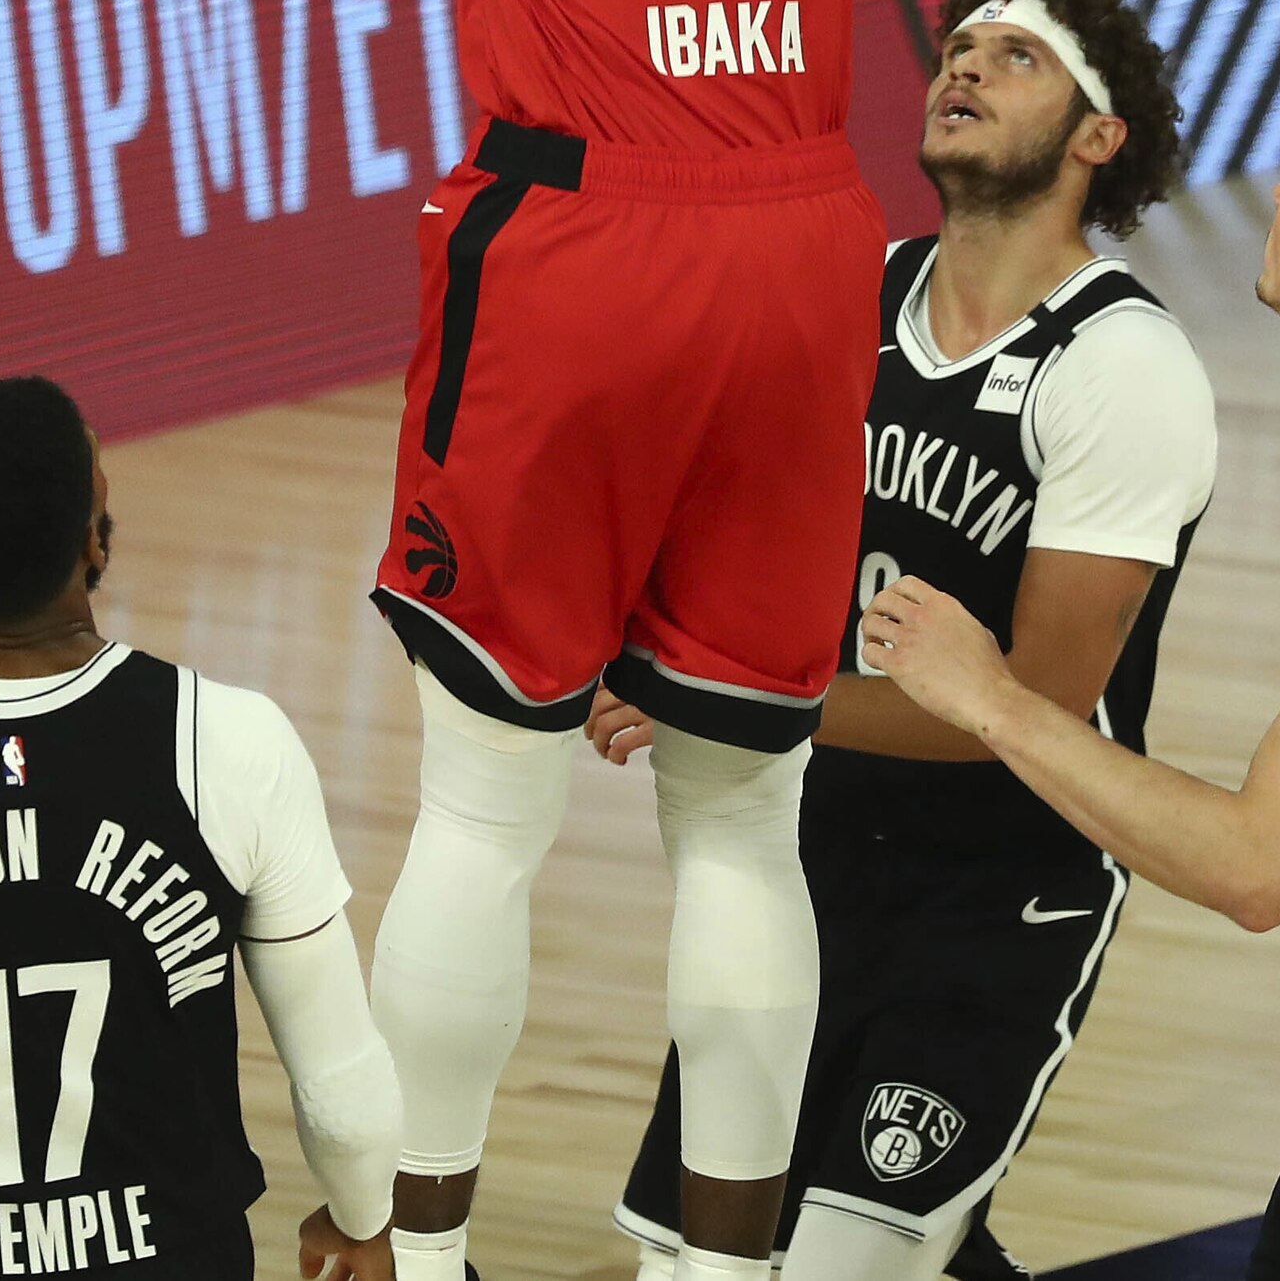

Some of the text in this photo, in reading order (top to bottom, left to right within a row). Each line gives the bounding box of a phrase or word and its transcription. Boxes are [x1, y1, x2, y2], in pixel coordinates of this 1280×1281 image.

[646, 0, 807, 79] IBAKA
[987, 373, 1025, 394] infor
[75, 819, 228, 1009] REFORM
[868, 1088, 958, 1148] NETS
[883, 1133, 908, 1166] B
